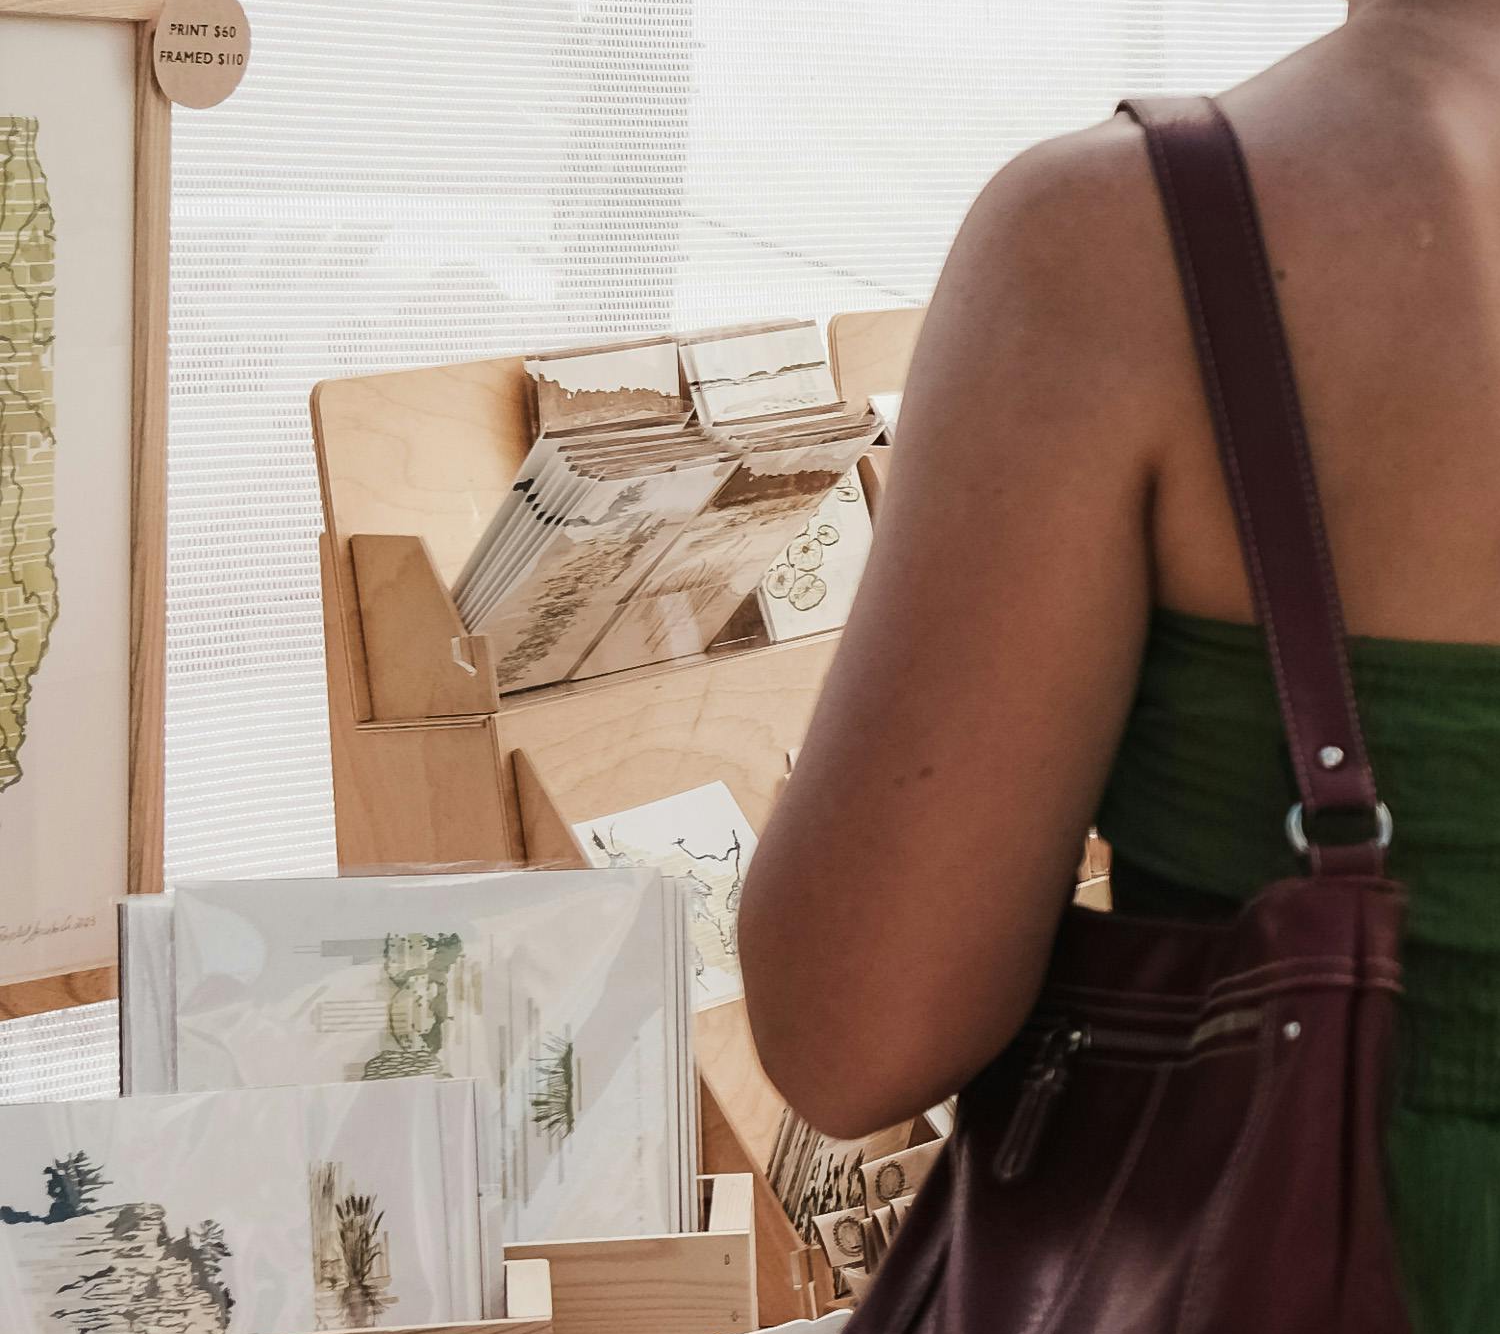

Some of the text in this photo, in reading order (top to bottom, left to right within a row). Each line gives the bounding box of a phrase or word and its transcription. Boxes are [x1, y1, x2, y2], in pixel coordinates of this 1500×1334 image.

[169, 23, 236, 38] PRINT $60
[160, 50, 243, 65] FRAMED $110
